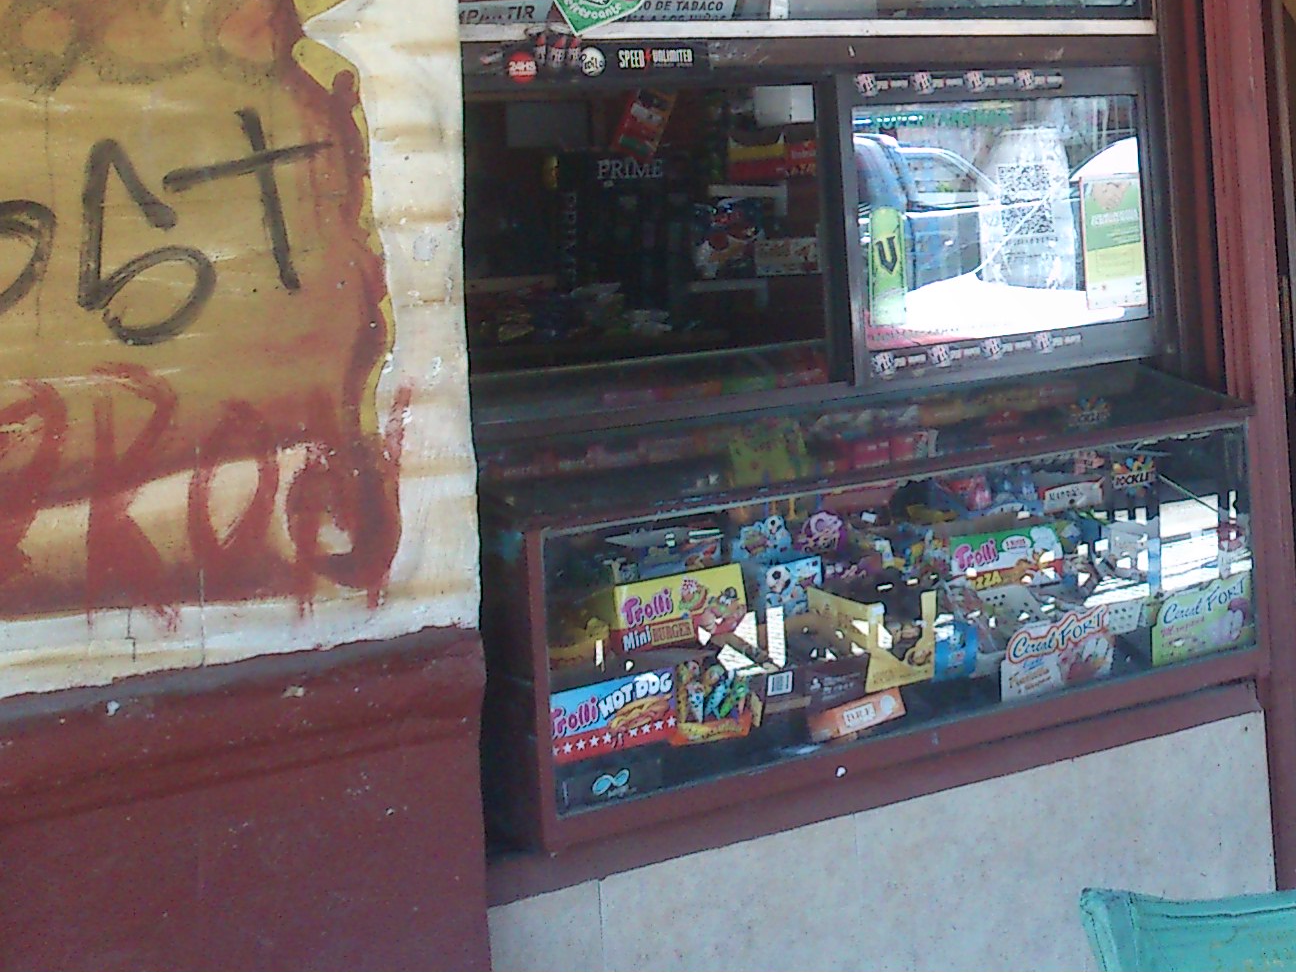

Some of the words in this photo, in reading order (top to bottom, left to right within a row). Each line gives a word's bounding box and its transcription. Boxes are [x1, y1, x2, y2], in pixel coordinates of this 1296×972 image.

[656, 1, 671, 11] DE
[676, 0, 723, 11] TABACO
[618, 49, 646, 69] SPEED
[652, 48, 693, 63] UNLIMITED
[596, 158, 663, 180] PRIME
[954, 538, 999, 572] Trolli
[622, 588, 673, 628] Trolli
[622, 625, 652, 652] Mini
[551, 696, 599, 740] Trolli
[598, 681, 635, 720] HOT
[633, 671, 674, 699] DOG
